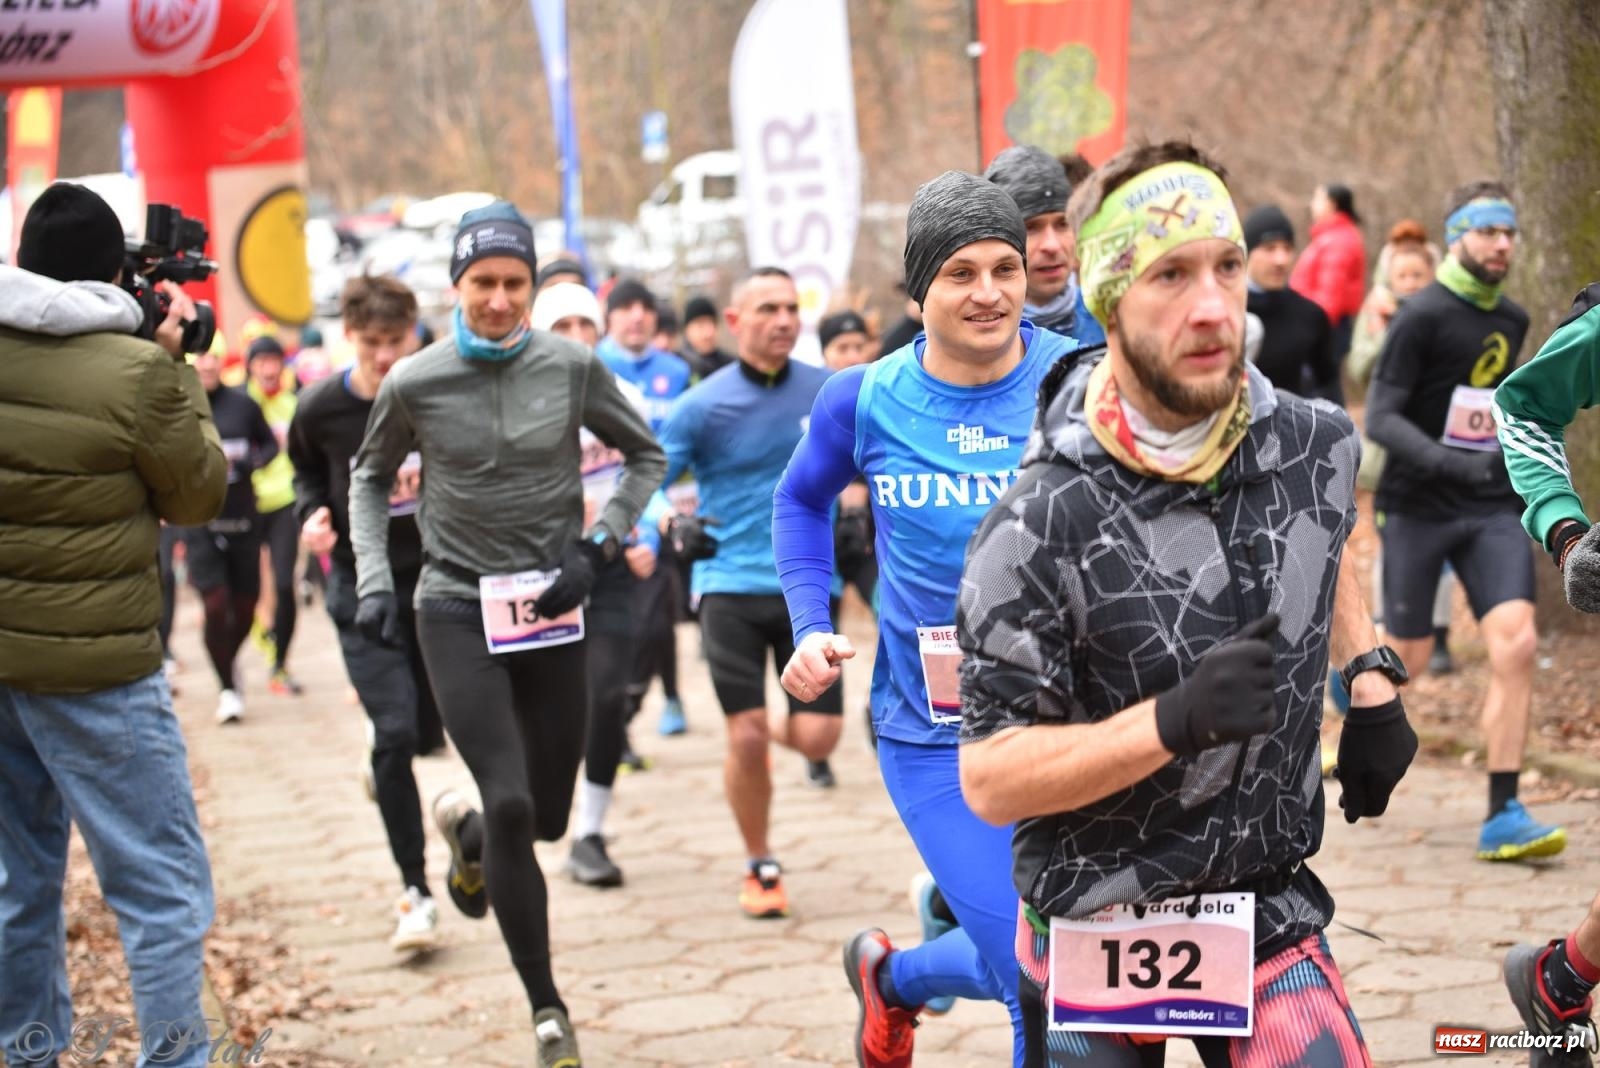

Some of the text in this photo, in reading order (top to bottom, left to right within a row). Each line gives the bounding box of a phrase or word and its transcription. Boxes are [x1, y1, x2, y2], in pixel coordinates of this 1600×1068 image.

[507, 599, 542, 626] 13
[1101, 939, 1202, 990] 132
[1168, 1008, 1215, 1021] Racibórz
